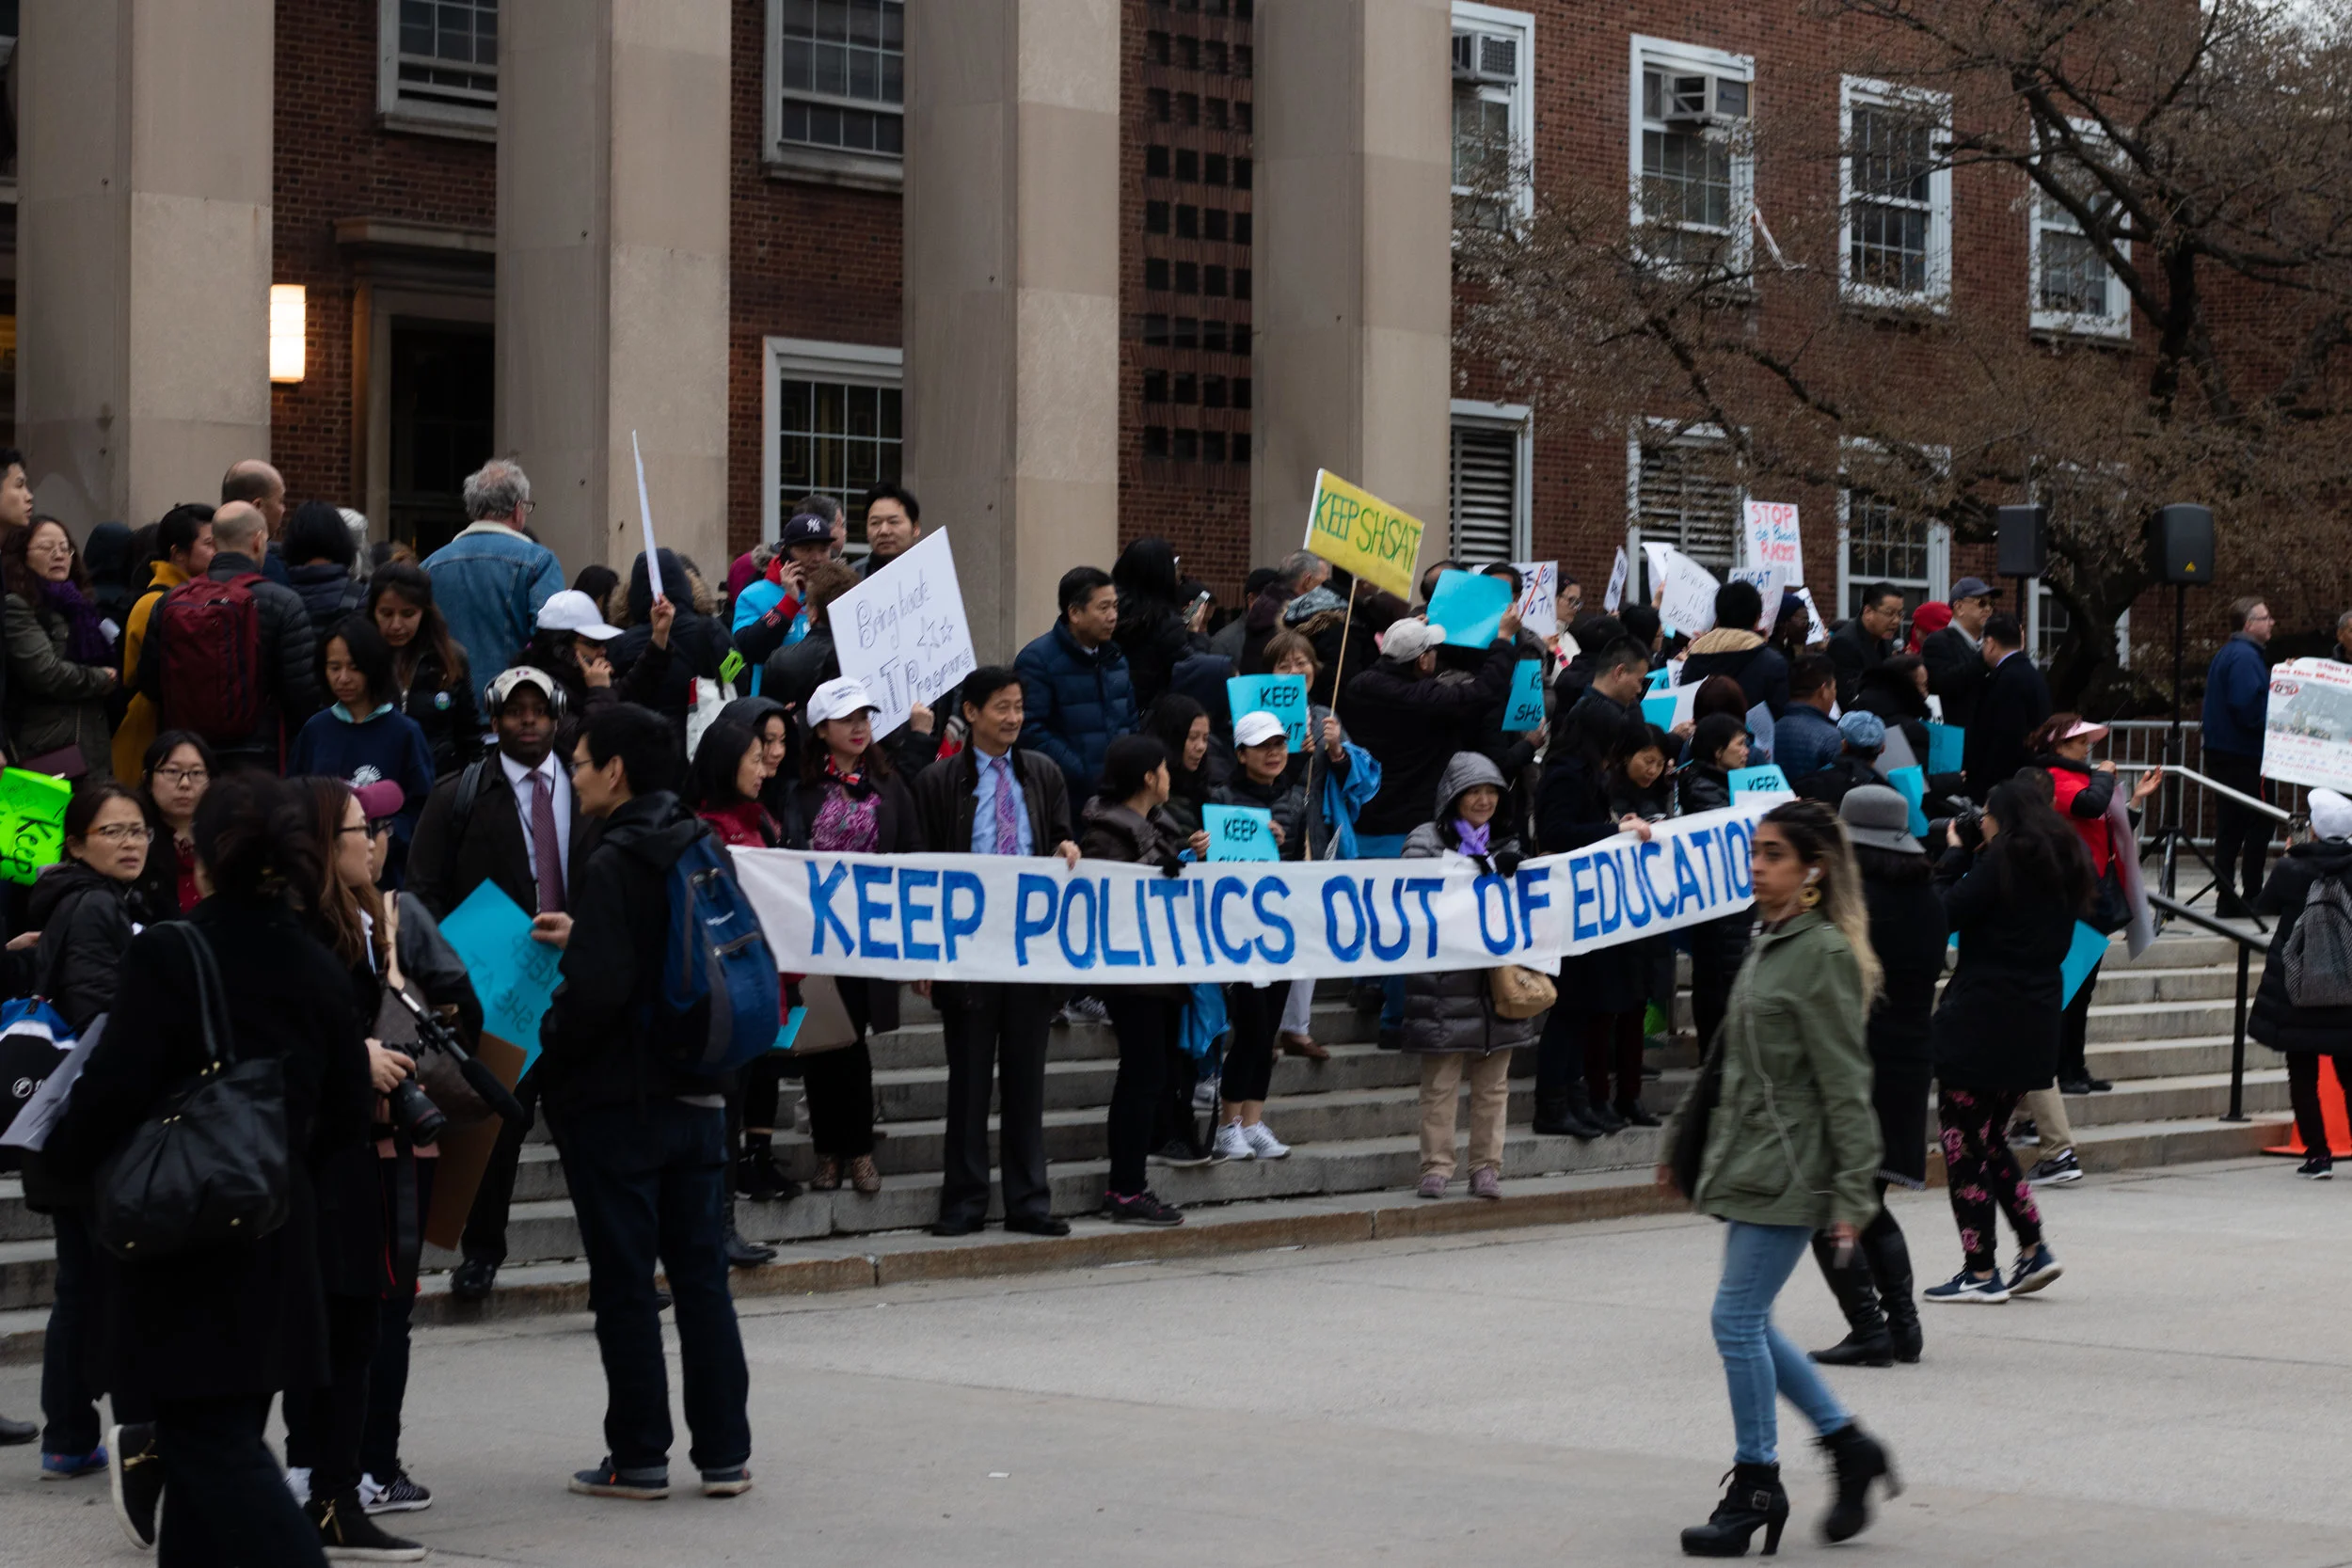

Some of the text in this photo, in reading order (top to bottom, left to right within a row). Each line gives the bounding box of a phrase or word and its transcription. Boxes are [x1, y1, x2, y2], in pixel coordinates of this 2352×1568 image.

[1751, 503, 1792, 529] STOP
[1314, 488, 1422, 573] KEEP SHSAT
[1260, 687, 1299, 707] KEEP
[1223, 817, 1259, 842] KEEP
[804, 860, 985, 963] KEEP
[1015, 872, 1295, 970] POLITICS
[1322, 875, 1445, 962] OUT
[1473, 867, 1551, 956] OF
